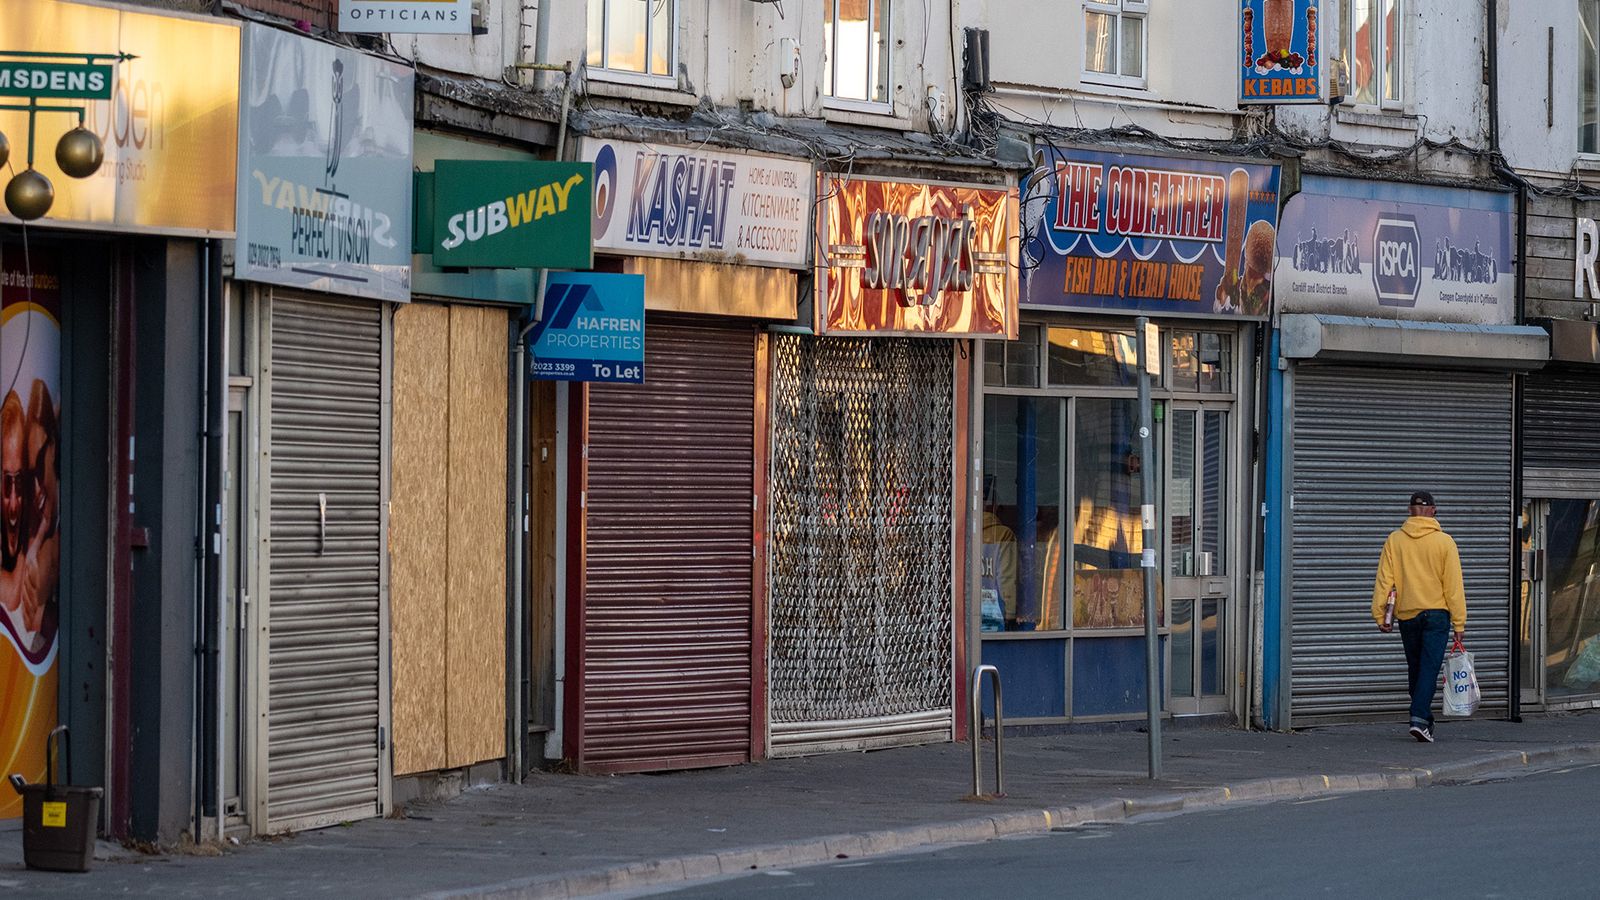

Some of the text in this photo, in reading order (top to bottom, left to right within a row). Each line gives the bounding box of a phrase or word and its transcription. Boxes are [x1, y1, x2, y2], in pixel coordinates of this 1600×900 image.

[350, 8, 458, 21] OPTICIANS
[1244, 78, 1317, 97] KEBABS
[749, 167, 765, 185] HOME
[771, 169, 798, 189] UNIVERSAL
[626, 151, 737, 249] KASHAT
[741, 191, 800, 222] KITCHENWARE
[1054, 160, 1226, 242] THE CODFATHER
[441, 173, 584, 251] SUBWAY
[291, 206, 370, 265] PERFECT VISION
[737, 225, 799, 253] & ACCESSORIES
[1379, 240, 1416, 278] RSPCA
[1064, 256, 1205, 301] FISH BAR & KEBAB HOUSE
[1292, 281, 1347, 295] Cardiff and District Branch
[1439, 291, 1454, 304] Cangen
[1455, 292, 1473, 304] Caerdydd
[577, 316, 641, 332] HAFREN
[547, 332, 641, 350] PROPERTIES
[555, 363, 575, 372] 3399
[592, 363, 640, 379] To Let
[1453, 671, 1468, 681] No
[1454, 683, 1470, 693] for
